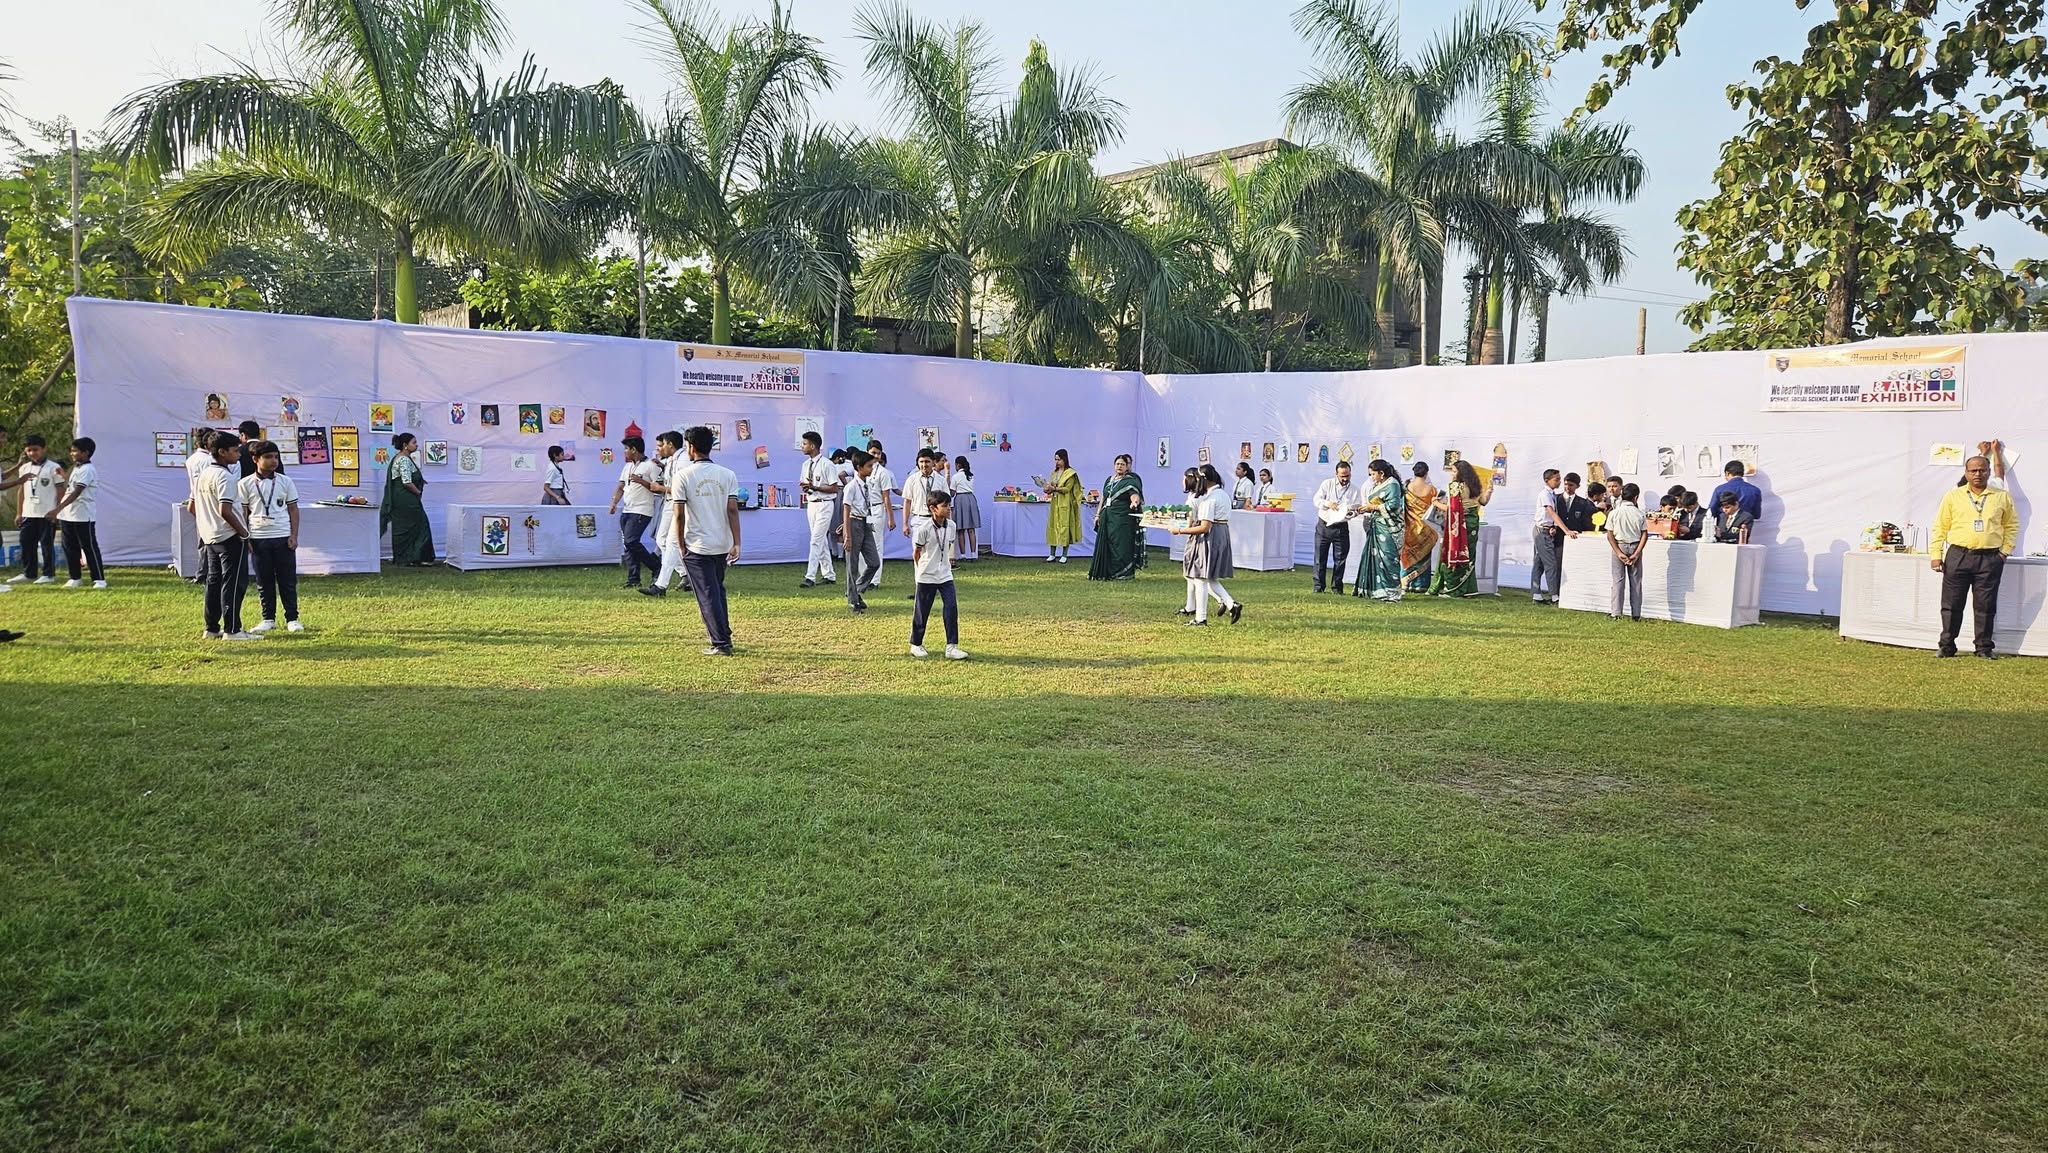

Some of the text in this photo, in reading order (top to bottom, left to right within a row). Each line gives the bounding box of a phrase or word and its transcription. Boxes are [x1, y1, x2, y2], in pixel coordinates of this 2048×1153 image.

[735, 351, 760, 359] Memorial
[761, 352, 780, 361] School
[1850, 352, 1888, 362] Memorial
[1891, 351, 1922, 362] School
[683, 371, 689, 379] We
[689, 371, 705, 381] heartily
[706, 372, 723, 381] welcome
[761, 374, 784, 383] ARTS
[743, 382, 800, 391] EXHIBITION
[1771, 384, 1860, 395] We heartily welcome you on our
[1874, 381, 1926, 392] & ARTS
[1861, 392, 1956, 402] EXHIBITION
